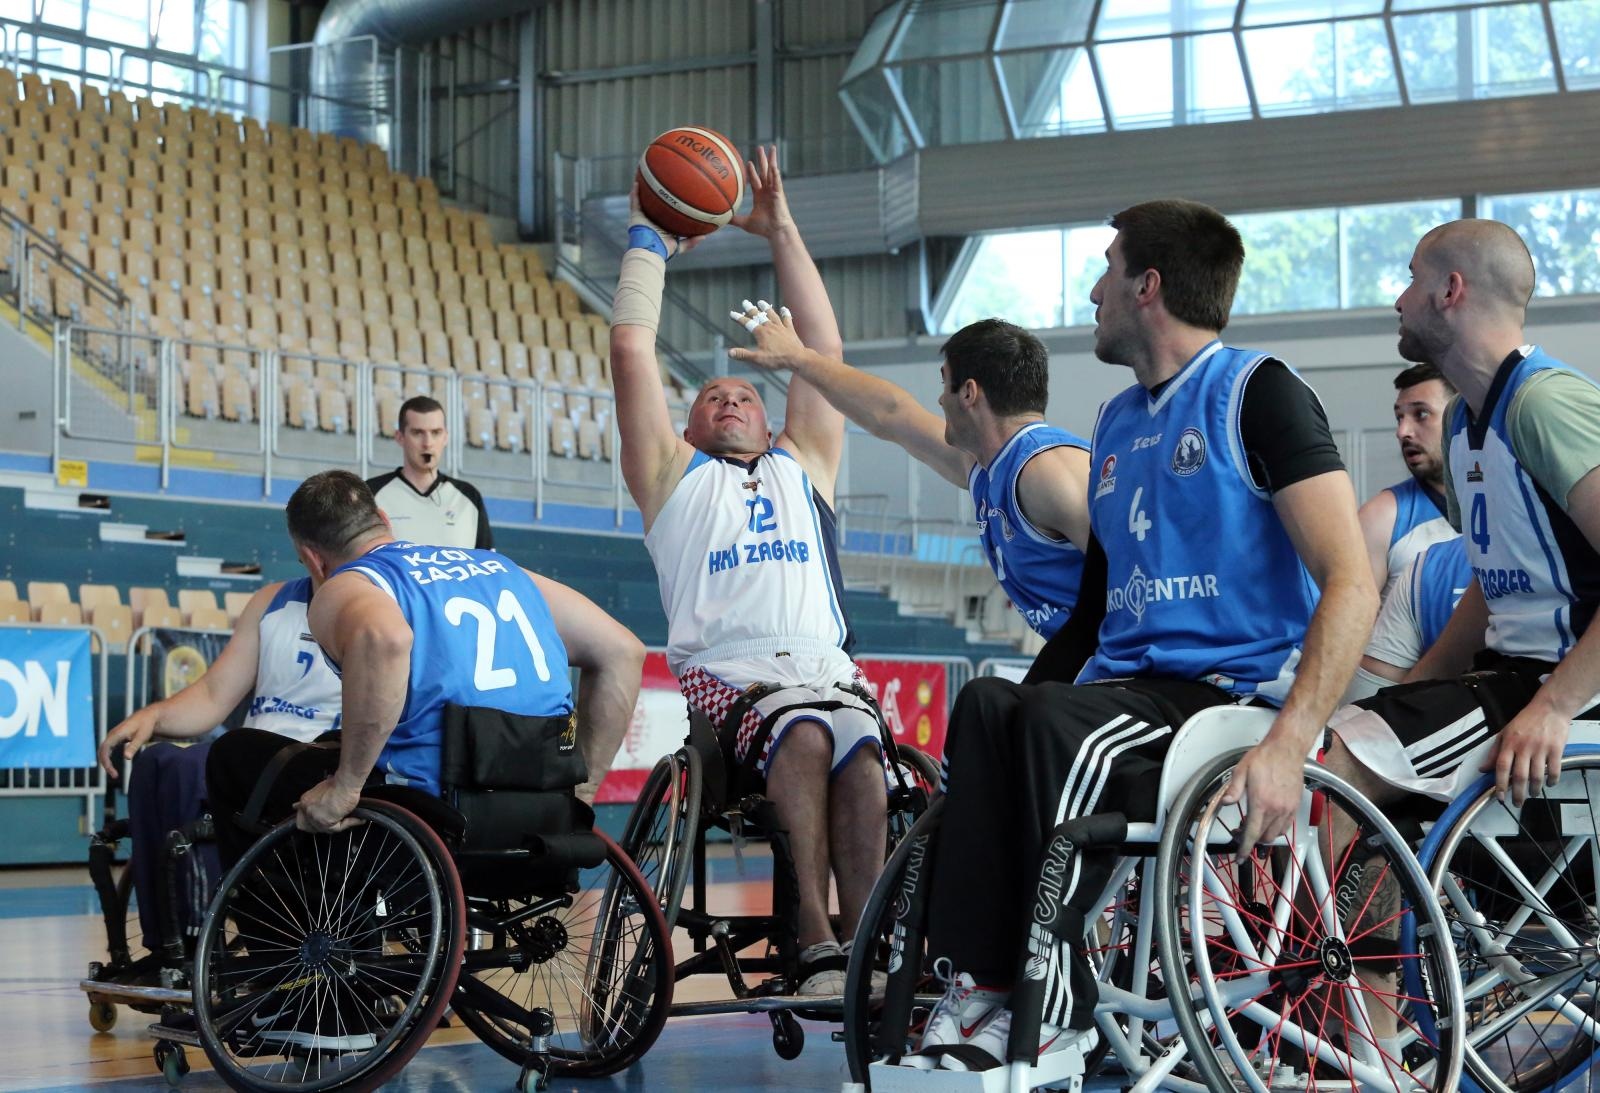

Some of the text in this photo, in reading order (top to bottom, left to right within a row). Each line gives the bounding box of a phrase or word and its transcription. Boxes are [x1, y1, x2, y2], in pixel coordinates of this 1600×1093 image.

[675, 135, 729, 180] molten
[745, 494, 778, 534] 12
[1128, 486, 1153, 542] 4
[1470, 492, 1491, 555] 4
[444, 589, 551, 692] 21
